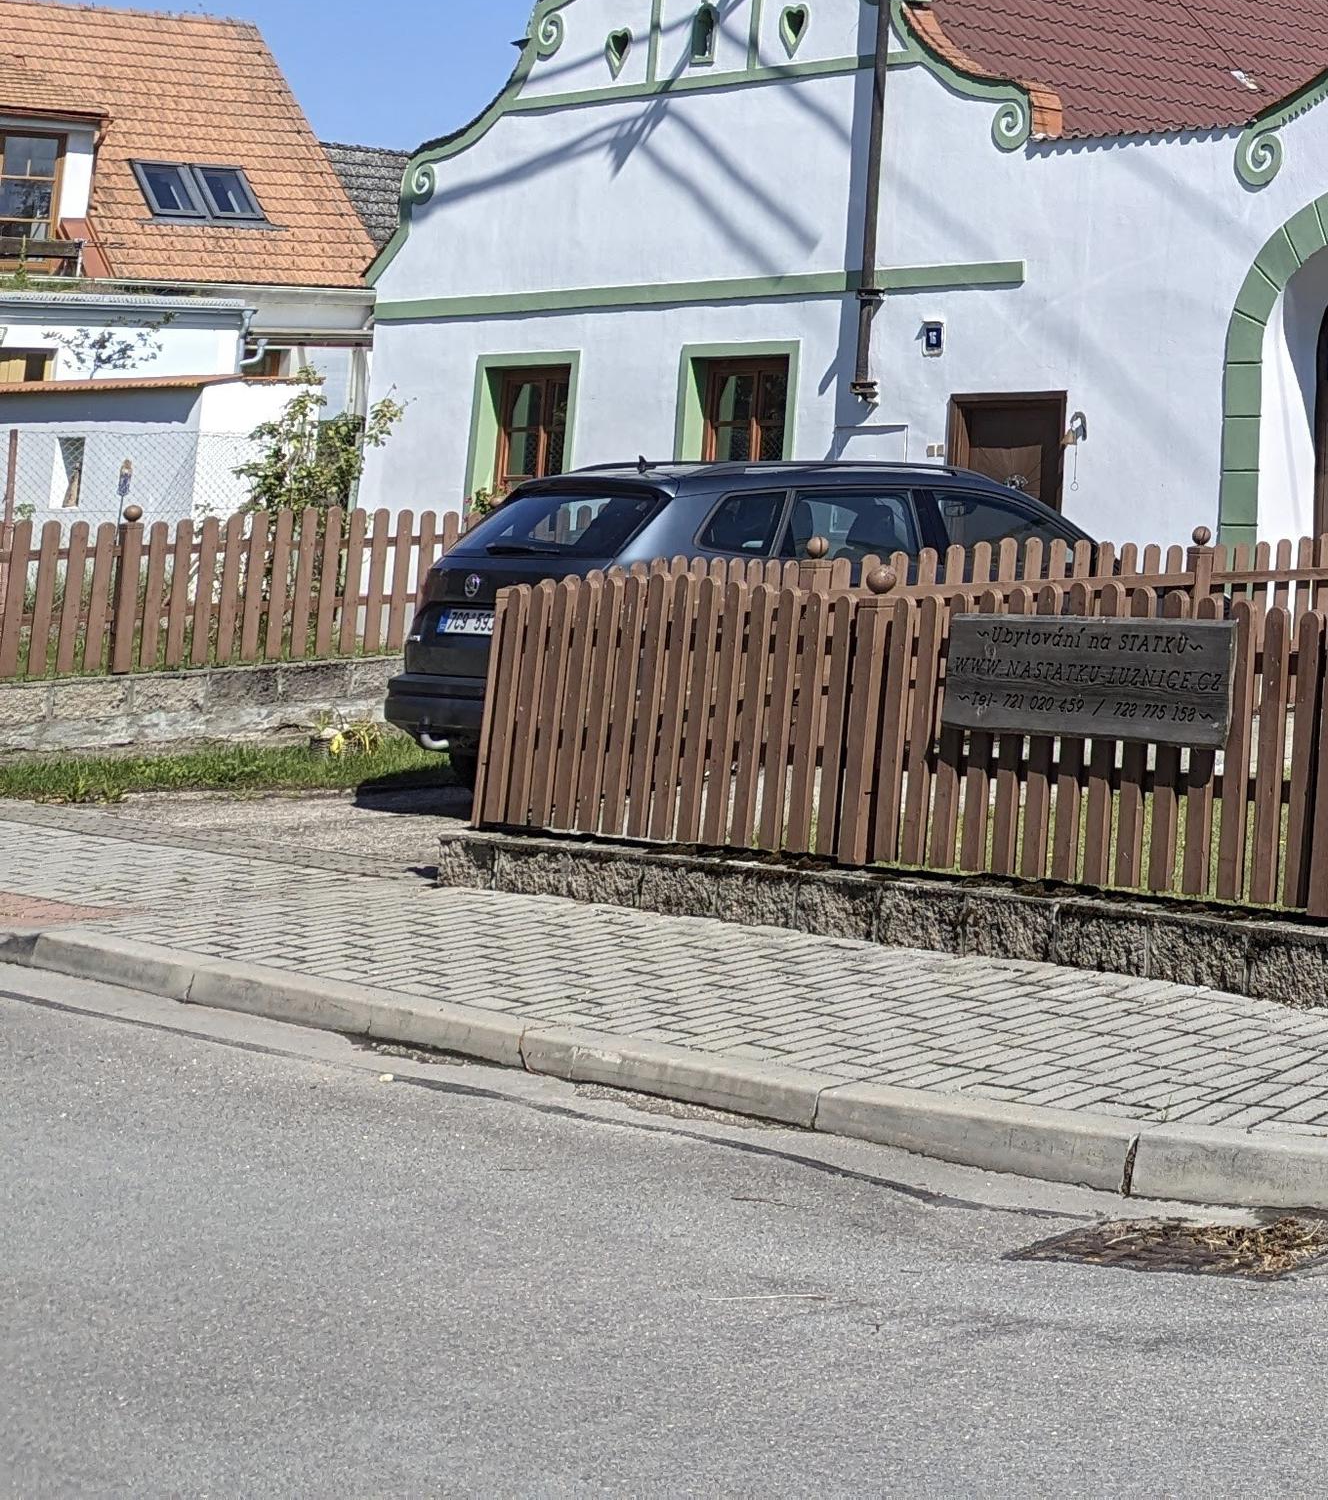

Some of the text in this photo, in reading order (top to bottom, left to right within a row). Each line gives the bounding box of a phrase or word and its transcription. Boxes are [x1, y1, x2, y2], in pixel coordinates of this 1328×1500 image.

[1088, 635, 1111, 650] na
[1002, 693, 1025, 709] 721
[1029, 695, 1055, 711] 020
[1092, 699, 1106, 716] /
[1142, 703, 1168, 720] 775
